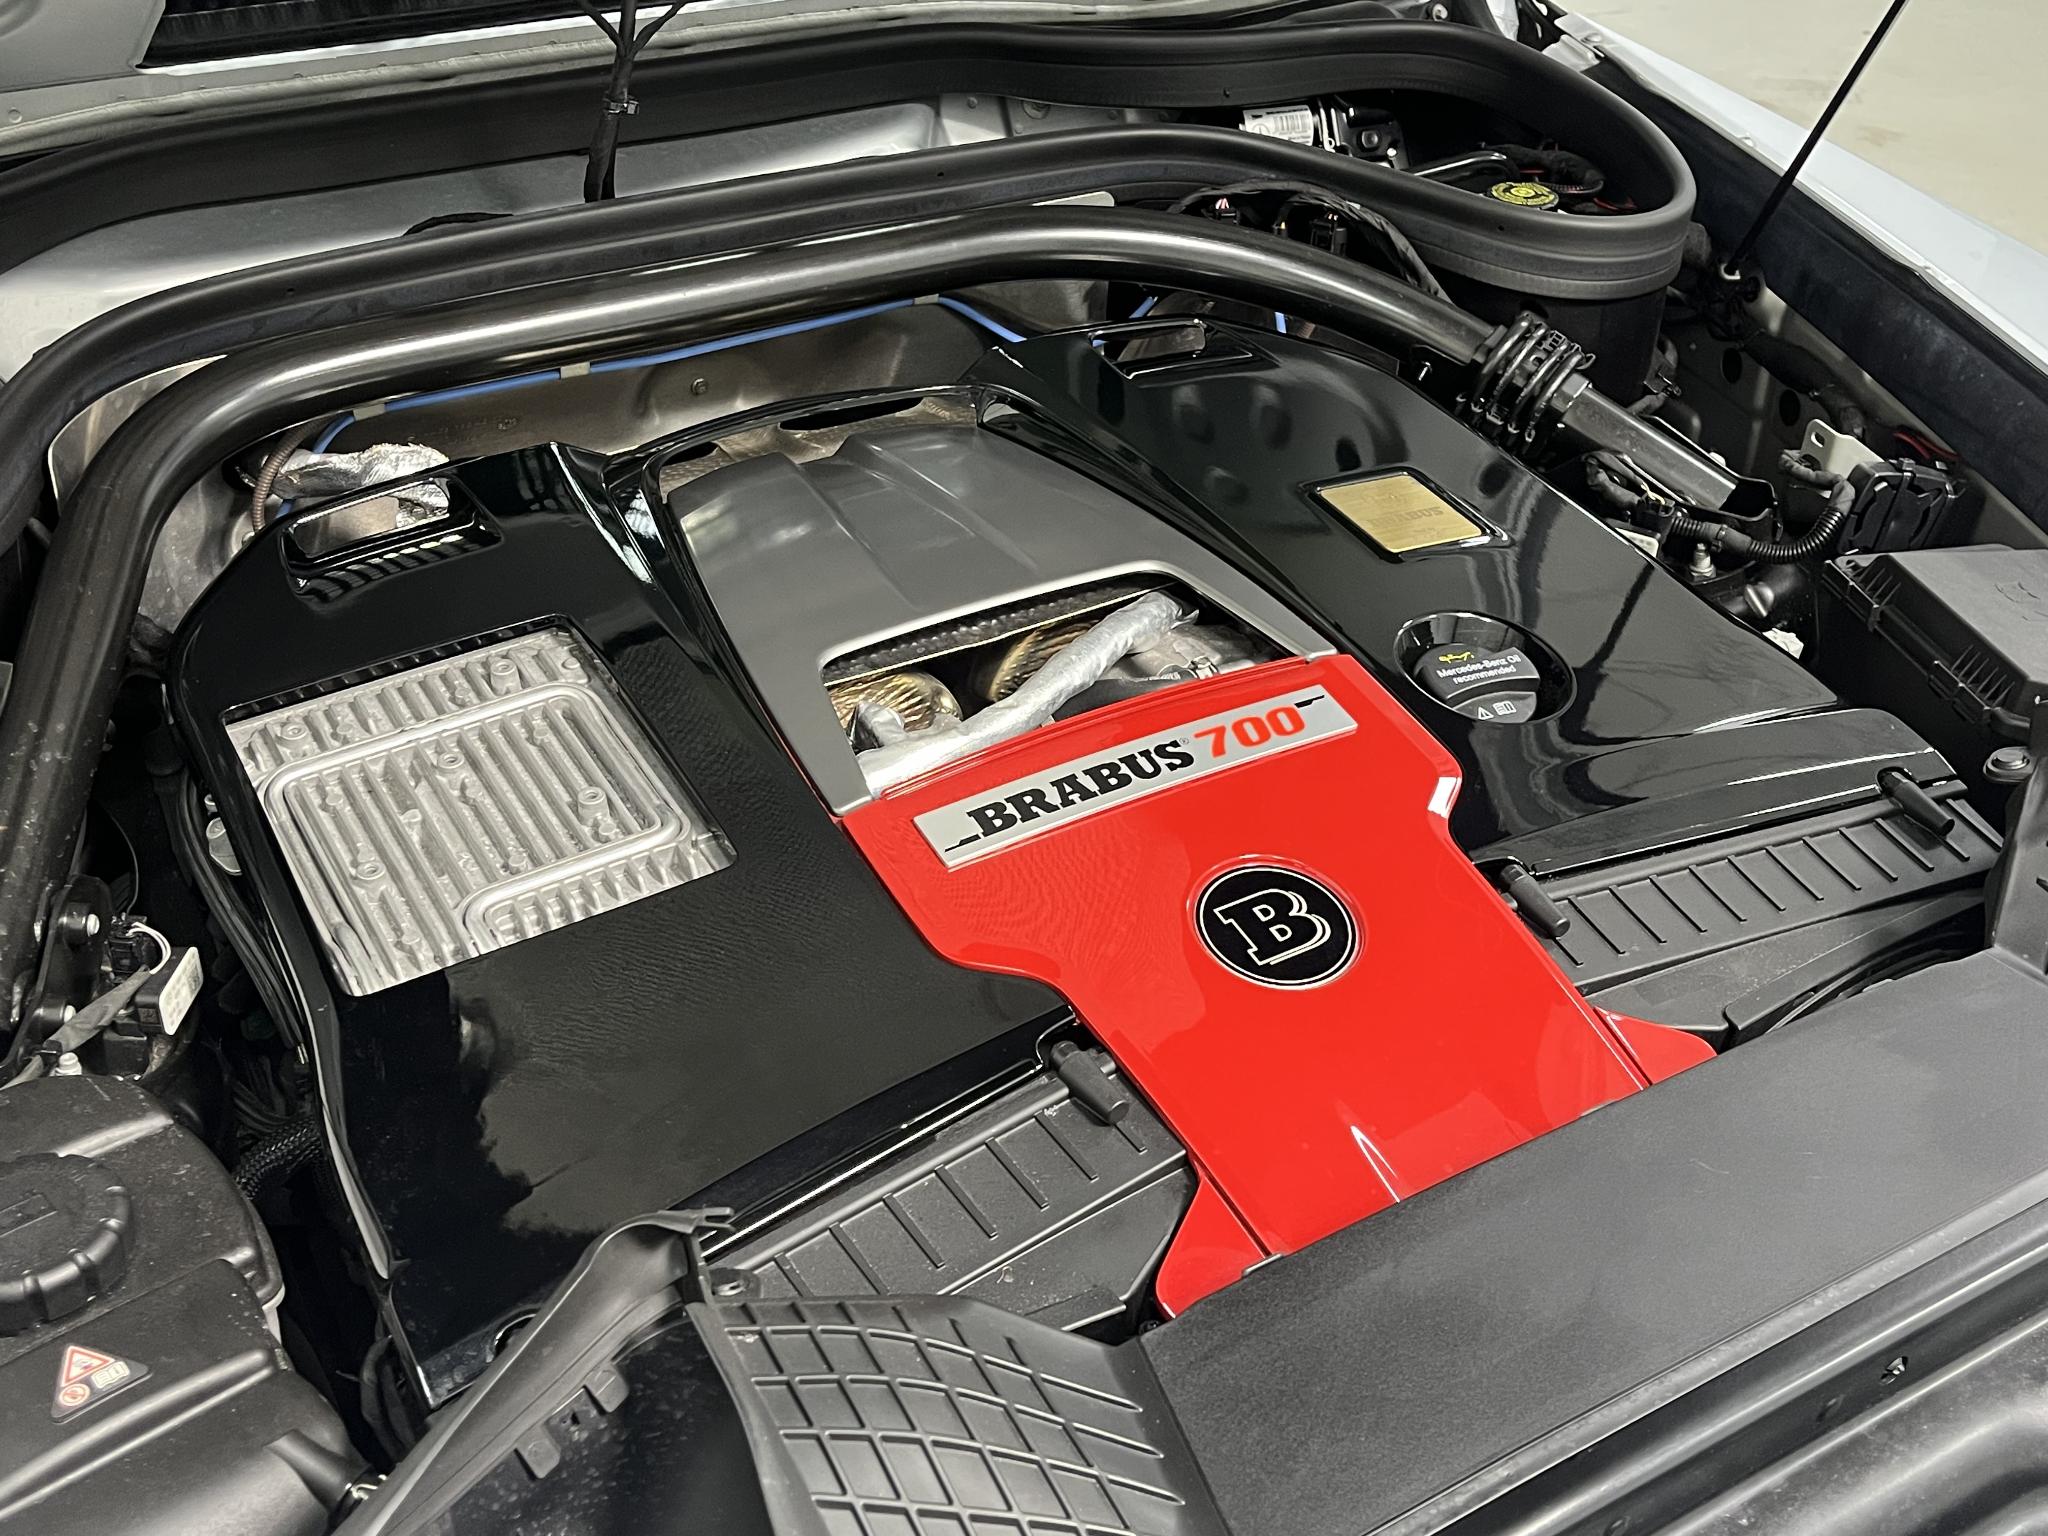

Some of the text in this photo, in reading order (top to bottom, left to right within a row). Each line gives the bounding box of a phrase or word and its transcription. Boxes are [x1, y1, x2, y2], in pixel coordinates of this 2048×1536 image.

[1436, 654, 1521, 678] Mercedes-Benz Oil
[1453, 664, 1517, 685] recommended
[966, 705, 1306, 837] BRABUS 700
[1213, 888, 1331, 966] B
